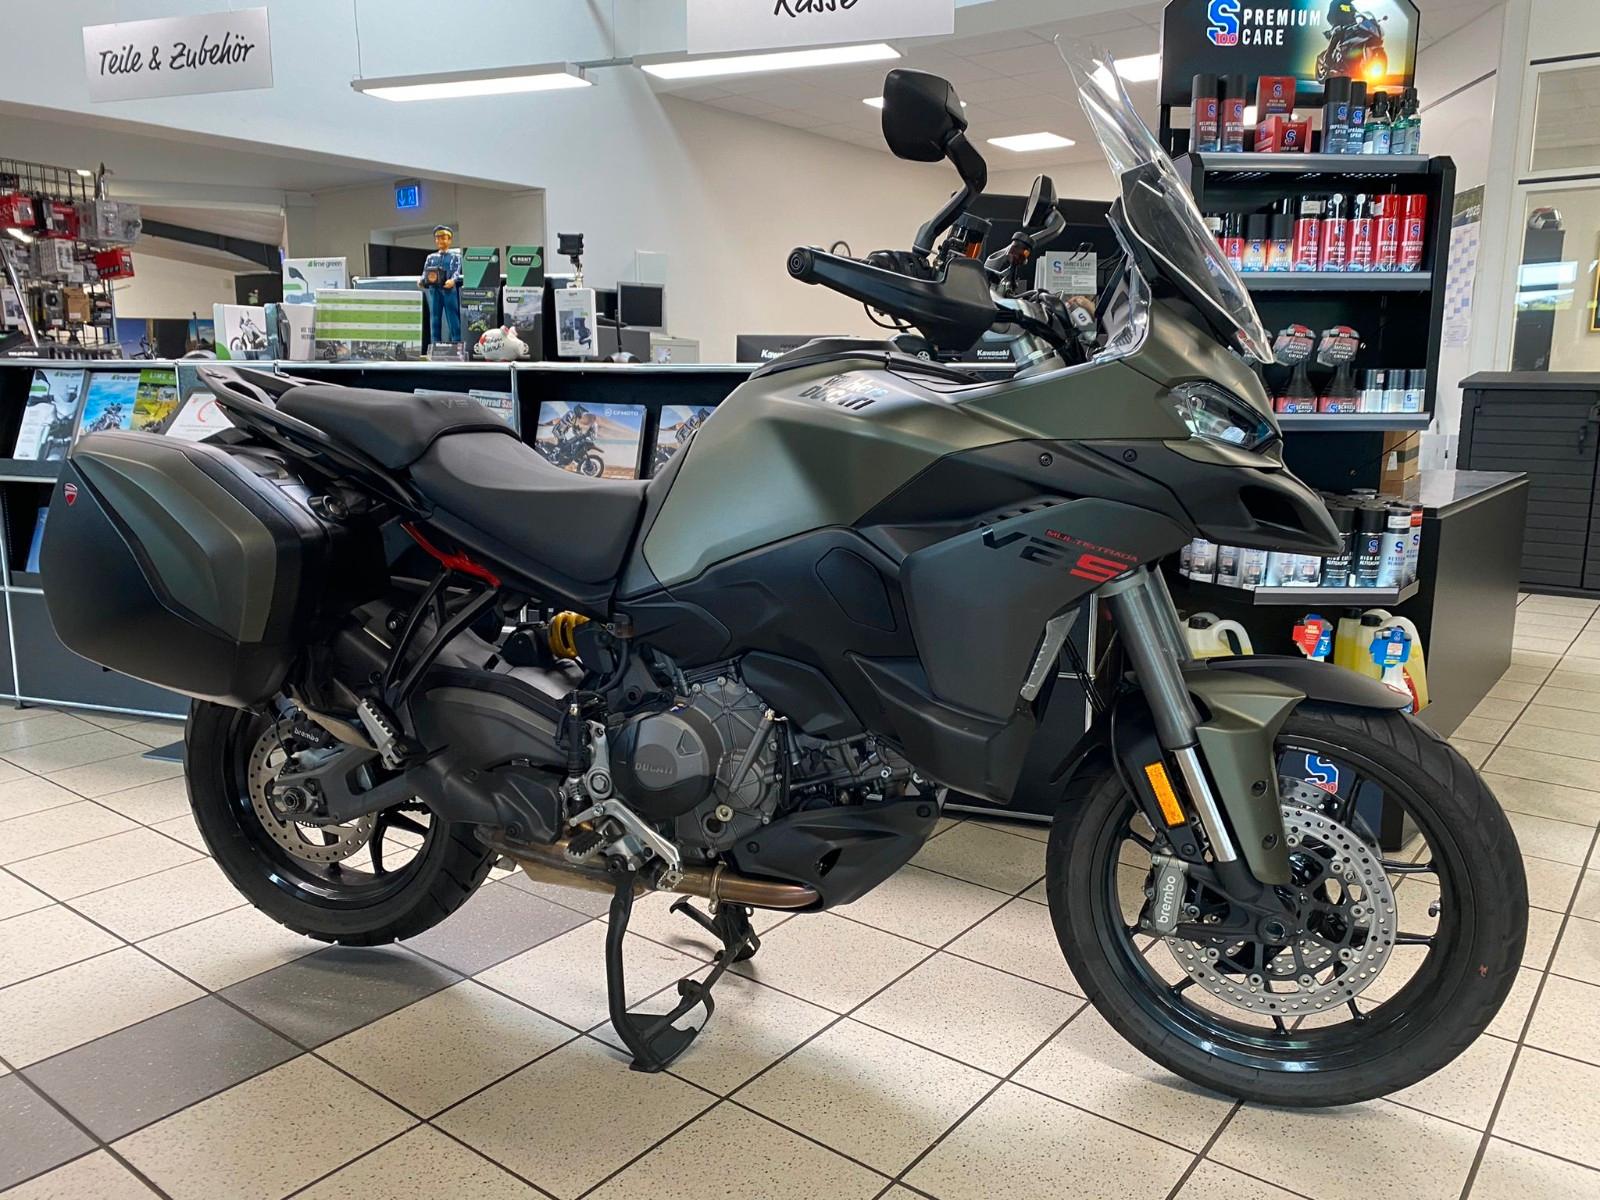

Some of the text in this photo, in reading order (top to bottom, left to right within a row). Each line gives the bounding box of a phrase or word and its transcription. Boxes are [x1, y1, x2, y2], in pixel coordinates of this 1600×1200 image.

[1243, 8, 1320, 26] PREMIUM
[1242, 28, 1284, 45] CARE
[99, 32, 255, 75] Teile & Zubehör
[294, 727, 320, 742] brembo
[1157, 875, 1176, 923] brembo
